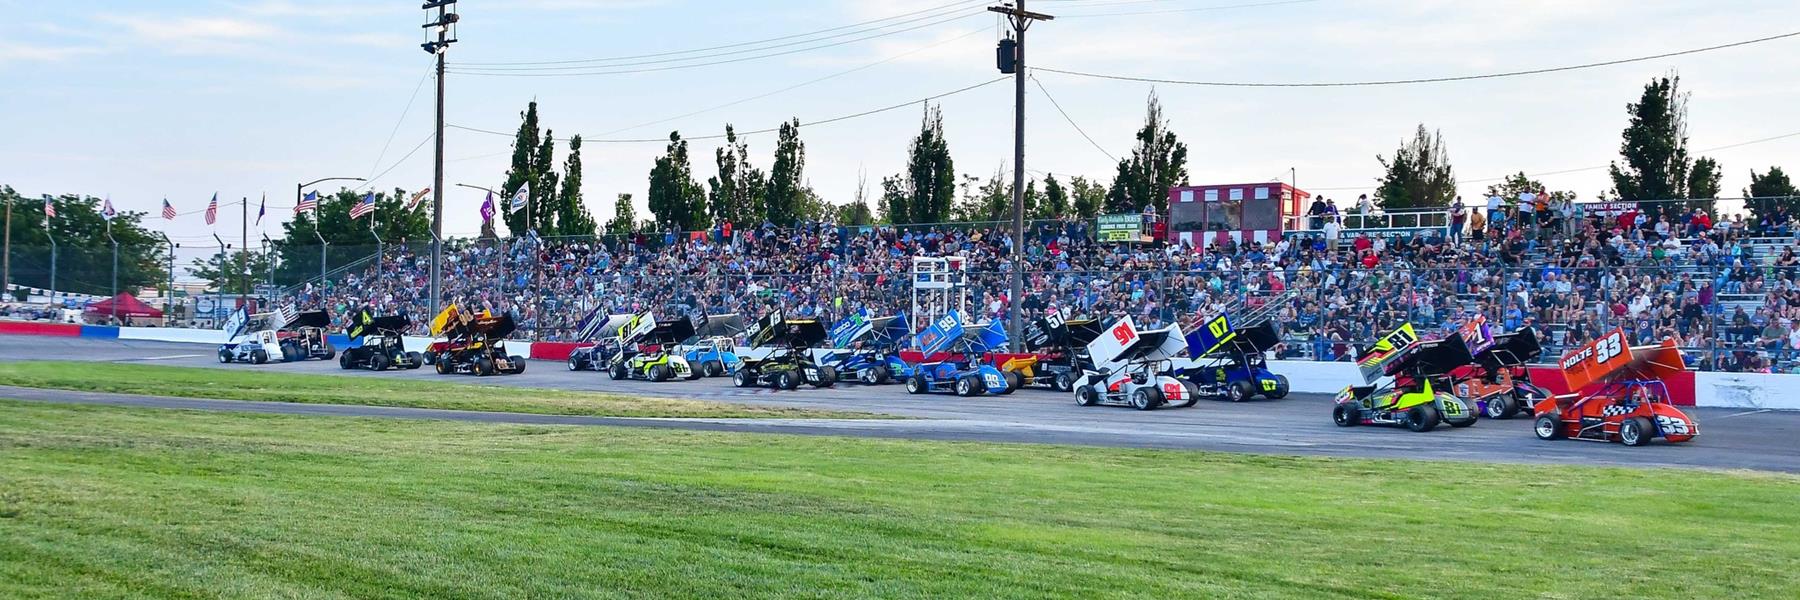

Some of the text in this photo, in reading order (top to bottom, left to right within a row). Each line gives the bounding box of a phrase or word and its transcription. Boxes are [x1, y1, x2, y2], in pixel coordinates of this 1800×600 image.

[362, 310, 373, 326] 4
[770, 308, 781, 327] 15
[938, 314, 958, 332] 99
[1045, 310, 1065, 329] 57
[1208, 315, 1229, 339] 07
[1112, 321, 1135, 346] 91
[1387, 329, 1414, 351] 81
[1472, 322, 1486, 344] 1
[1562, 346, 1593, 370] HOLTE
[1595, 331, 1622, 364] 33
[1163, 383, 1182, 400] 91
[1525, 392, 1535, 408] 1
[1656, 415, 1689, 435] 33
